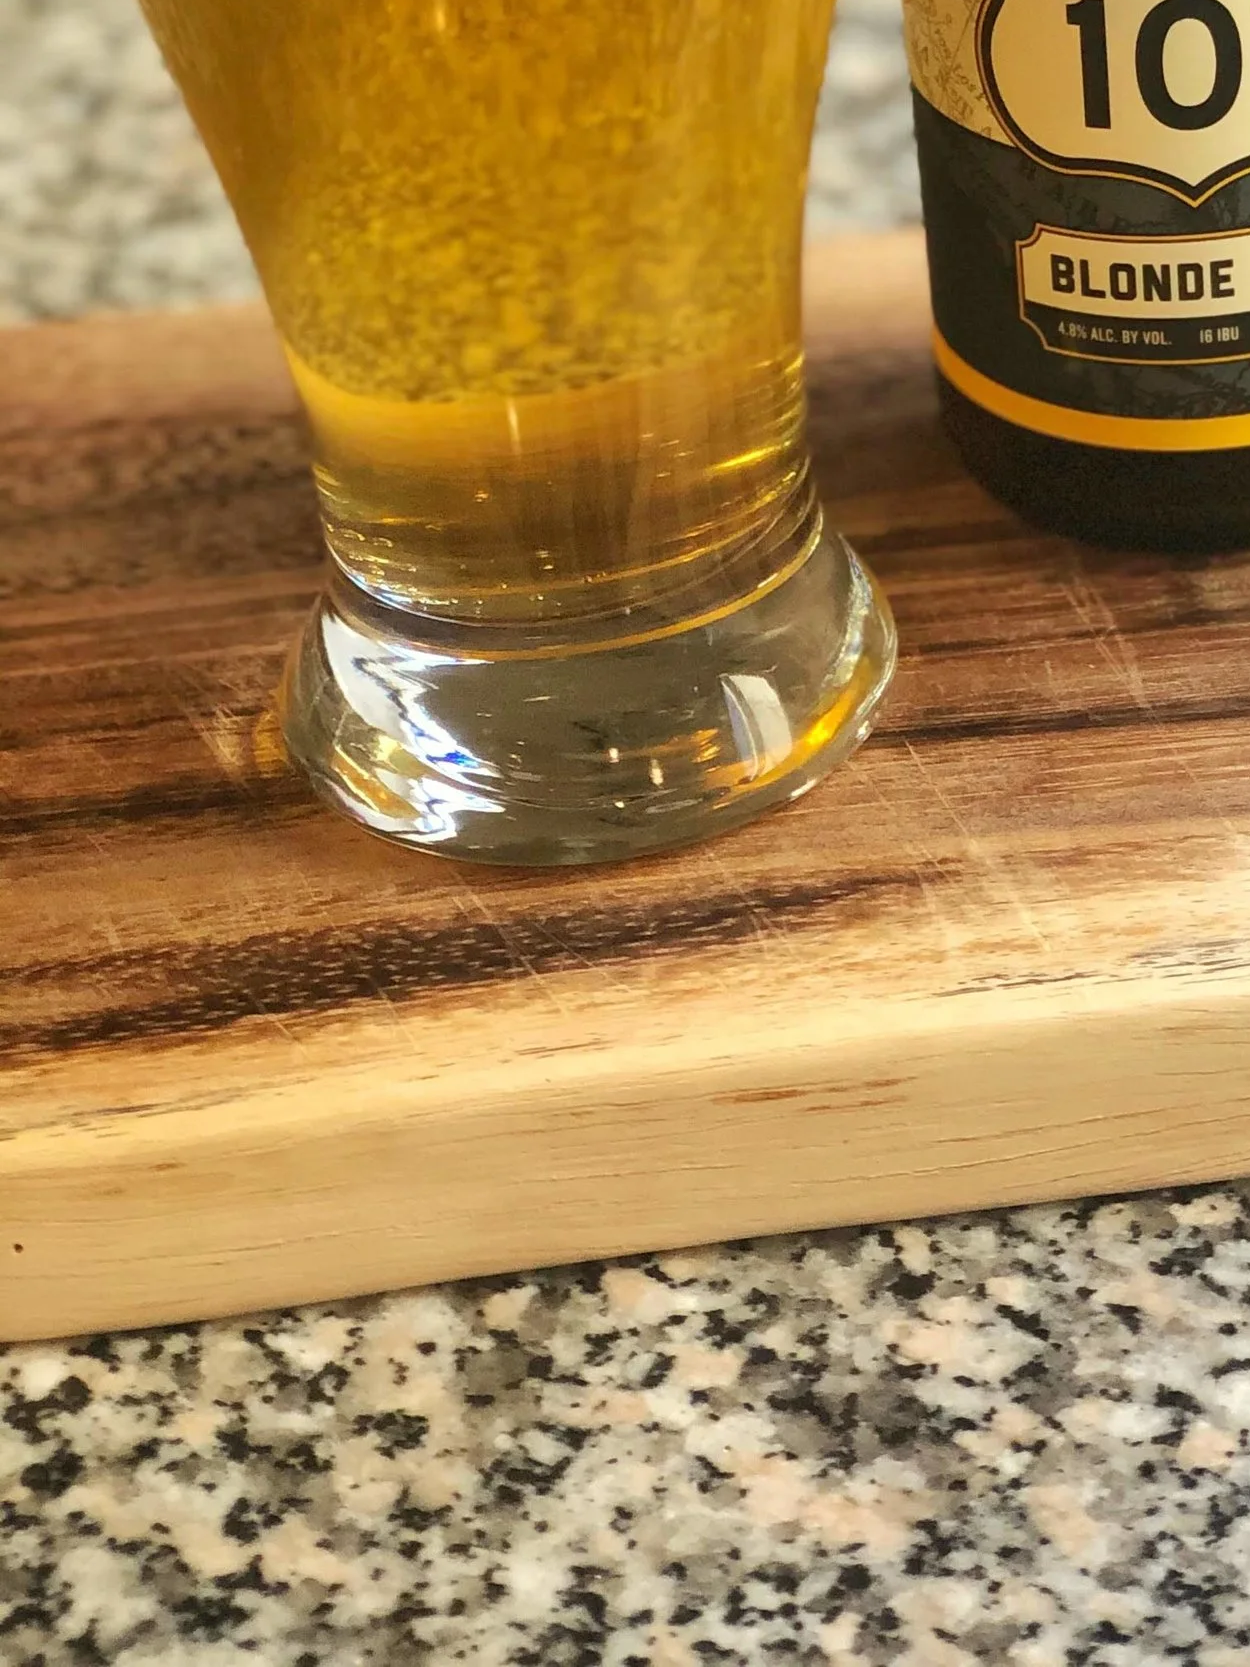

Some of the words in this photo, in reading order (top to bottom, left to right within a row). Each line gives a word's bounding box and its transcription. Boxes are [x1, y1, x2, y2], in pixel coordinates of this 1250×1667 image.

[1050, 253, 1235, 302] BLONDE
[1058, 321, 1088, 340] 4.8%
[1091, 327, 1118, 343] ALC.
[1122, 329, 1138, 344] BY
[1142, 330, 1172, 346] VOL.
[1199, 329, 1213, 343] 16
[1217, 326, 1239, 342] IBU
